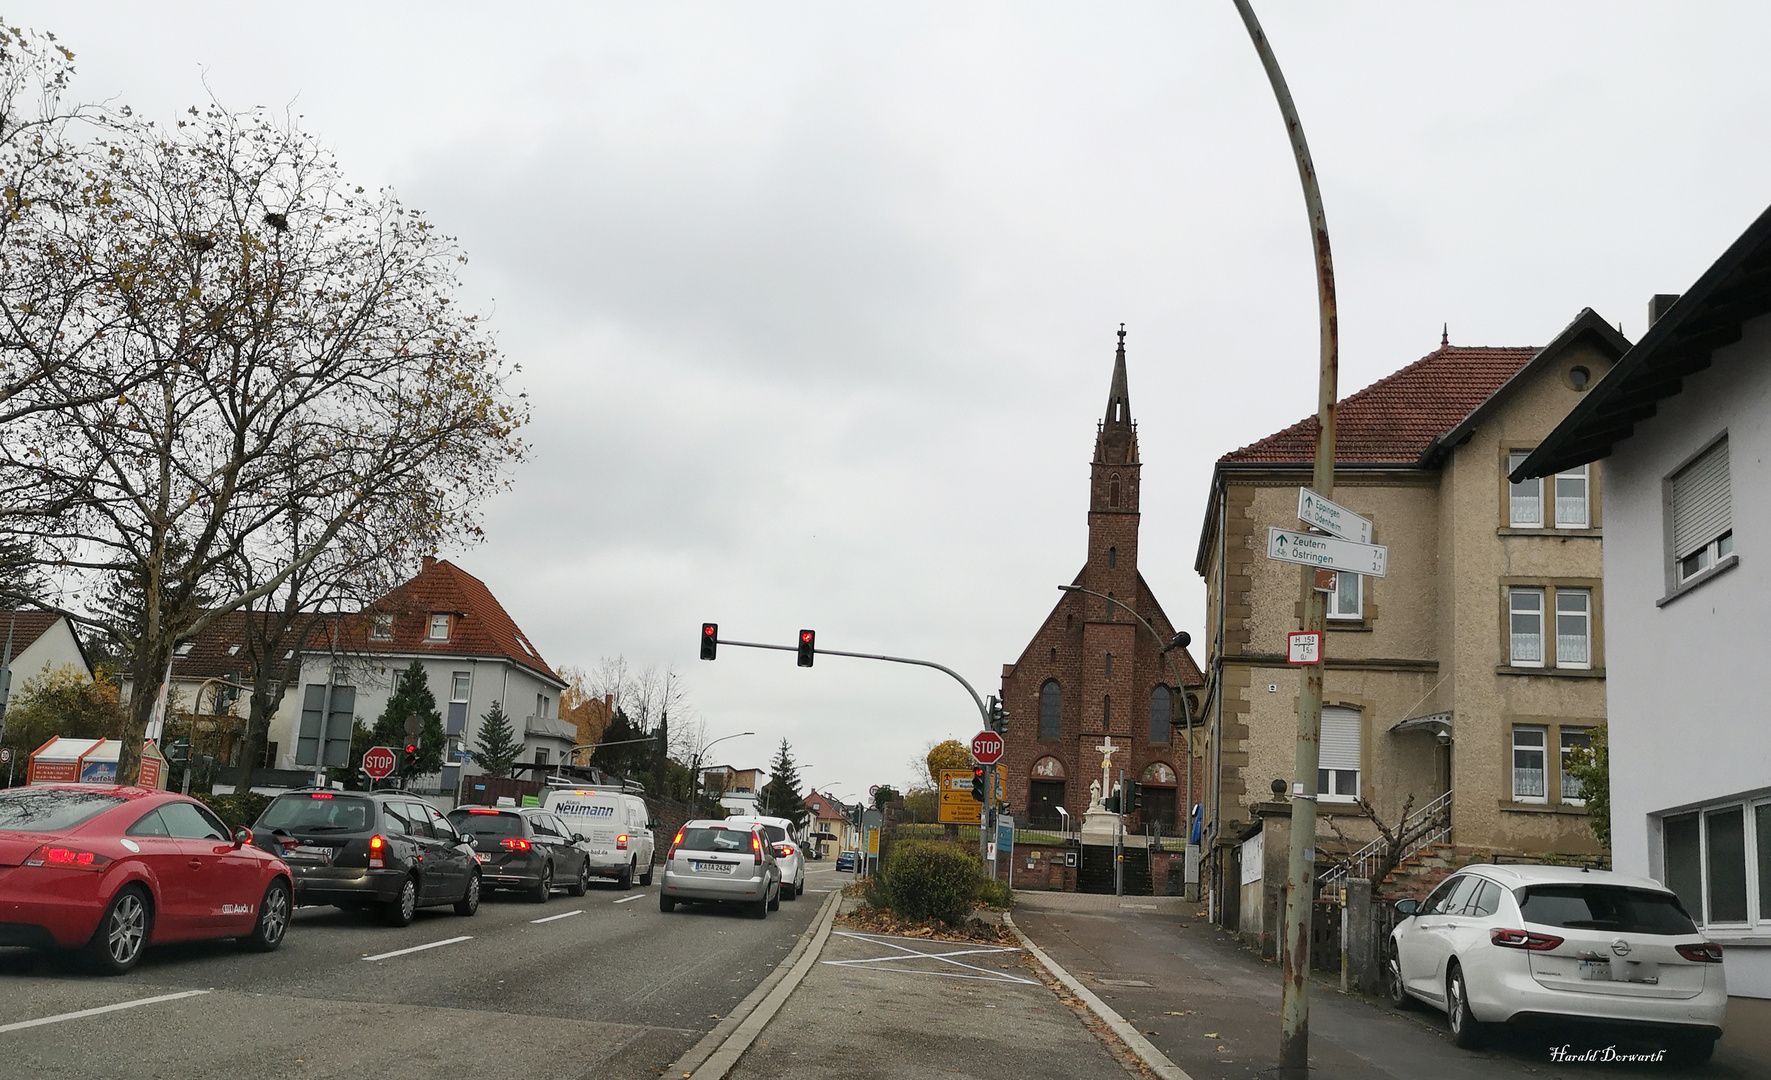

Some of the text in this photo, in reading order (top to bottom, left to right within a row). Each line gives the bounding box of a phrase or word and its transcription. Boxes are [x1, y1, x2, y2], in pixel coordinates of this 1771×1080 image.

[1315, 499, 1341, 519] Eppingen
[1314, 512, 1342, 532] Odenheim
[1293, 536, 1327, 550] Zeutern
[1292, 548, 1334, 564] Östringen
[973, 740, 1001, 755] STOP
[365, 755, 393, 769] STOP
[86, 774, 115, 782] Perfekt
[554, 802, 615, 817] Neumann
[233, 903, 249, 914] Audi
